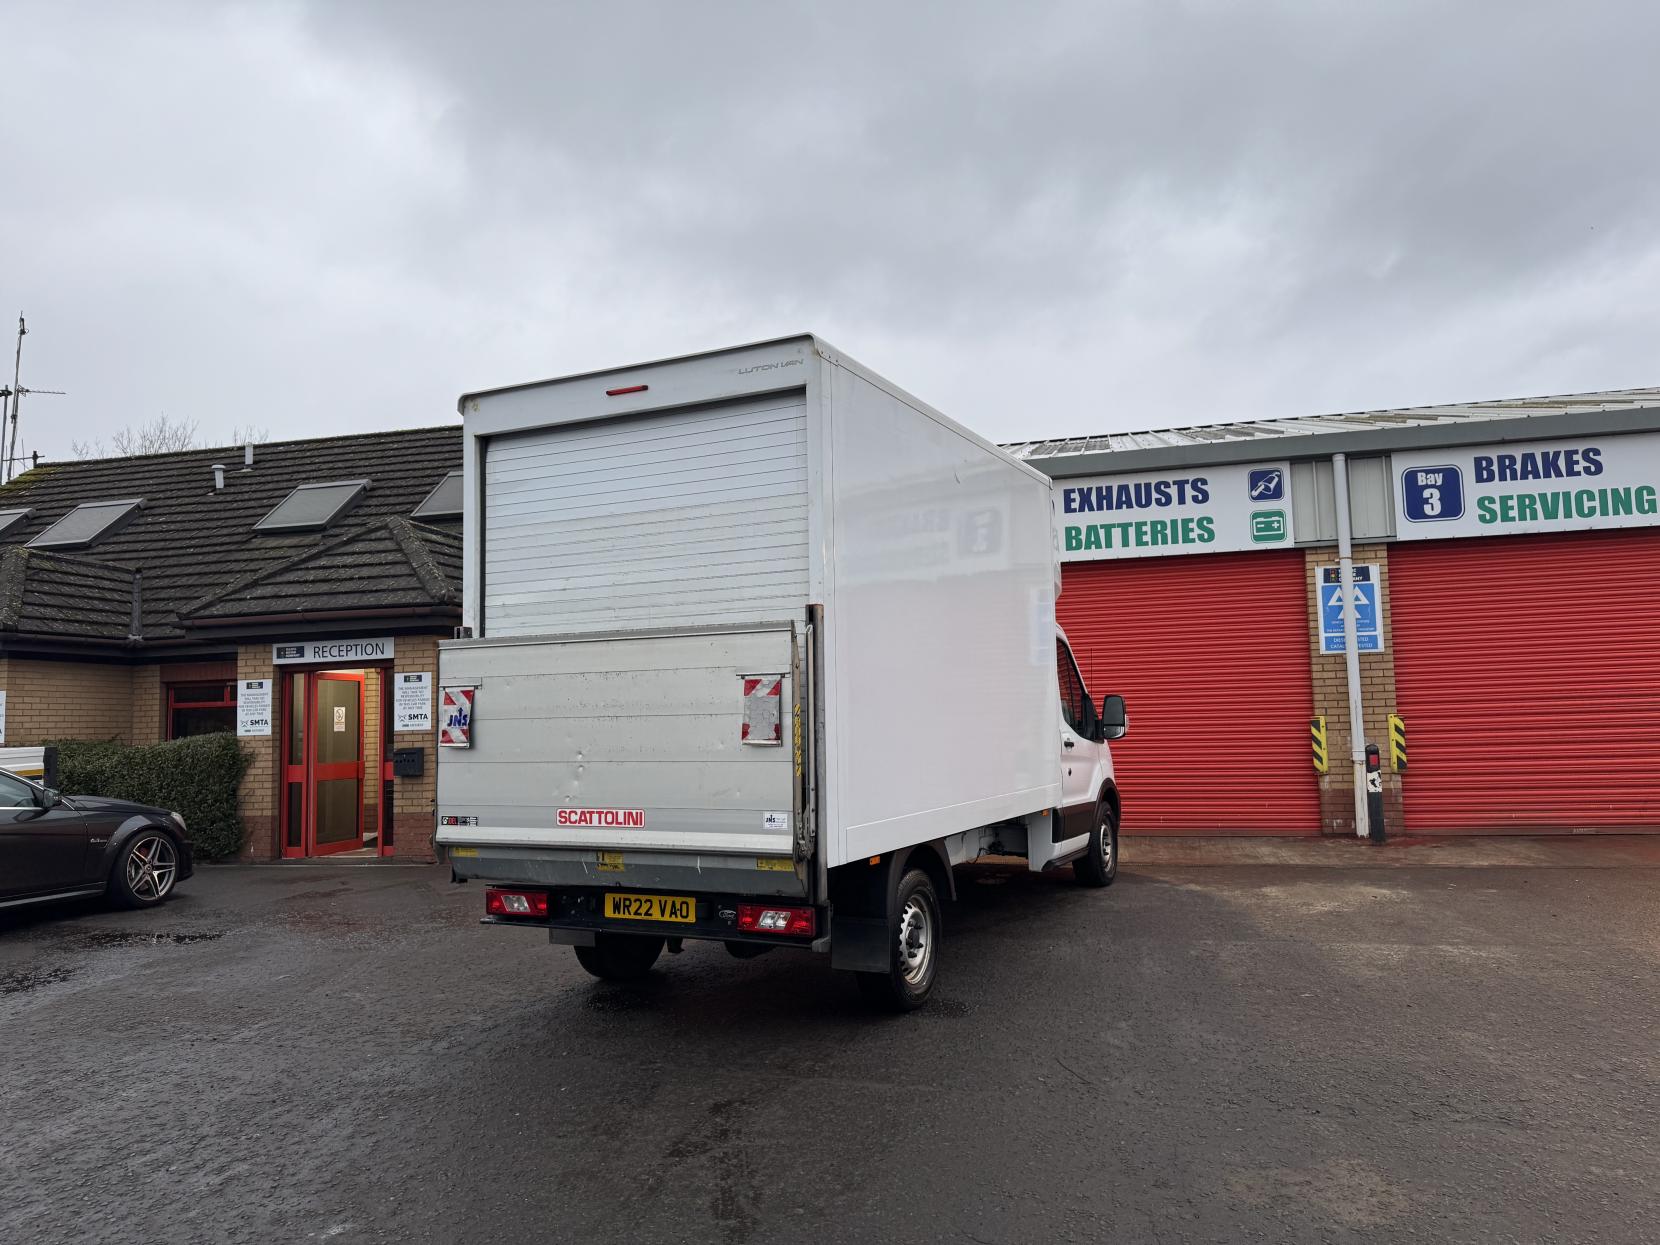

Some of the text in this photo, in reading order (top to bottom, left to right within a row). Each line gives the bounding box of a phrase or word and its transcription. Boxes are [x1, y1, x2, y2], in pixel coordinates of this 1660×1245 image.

[738, 362, 779, 375] LUTON
[1473, 447, 1604, 484] BRAKES
[1417, 471, 1443, 487] Bay
[1063, 477, 1210, 514] EXHAUSTS
[1422, 488, 1442, 516] 3
[1476, 485, 1658, 525] SERVICING
[1064, 516, 1216, 552] BATTERIES
[313, 642, 385, 659] RECEPTION
[408, 713, 429, 721] SMTA
[447, 713, 468, 727] JNS
[557, 809, 643, 826] SCATTOLINI
[612, 896, 690, 919] WR22 VAO
